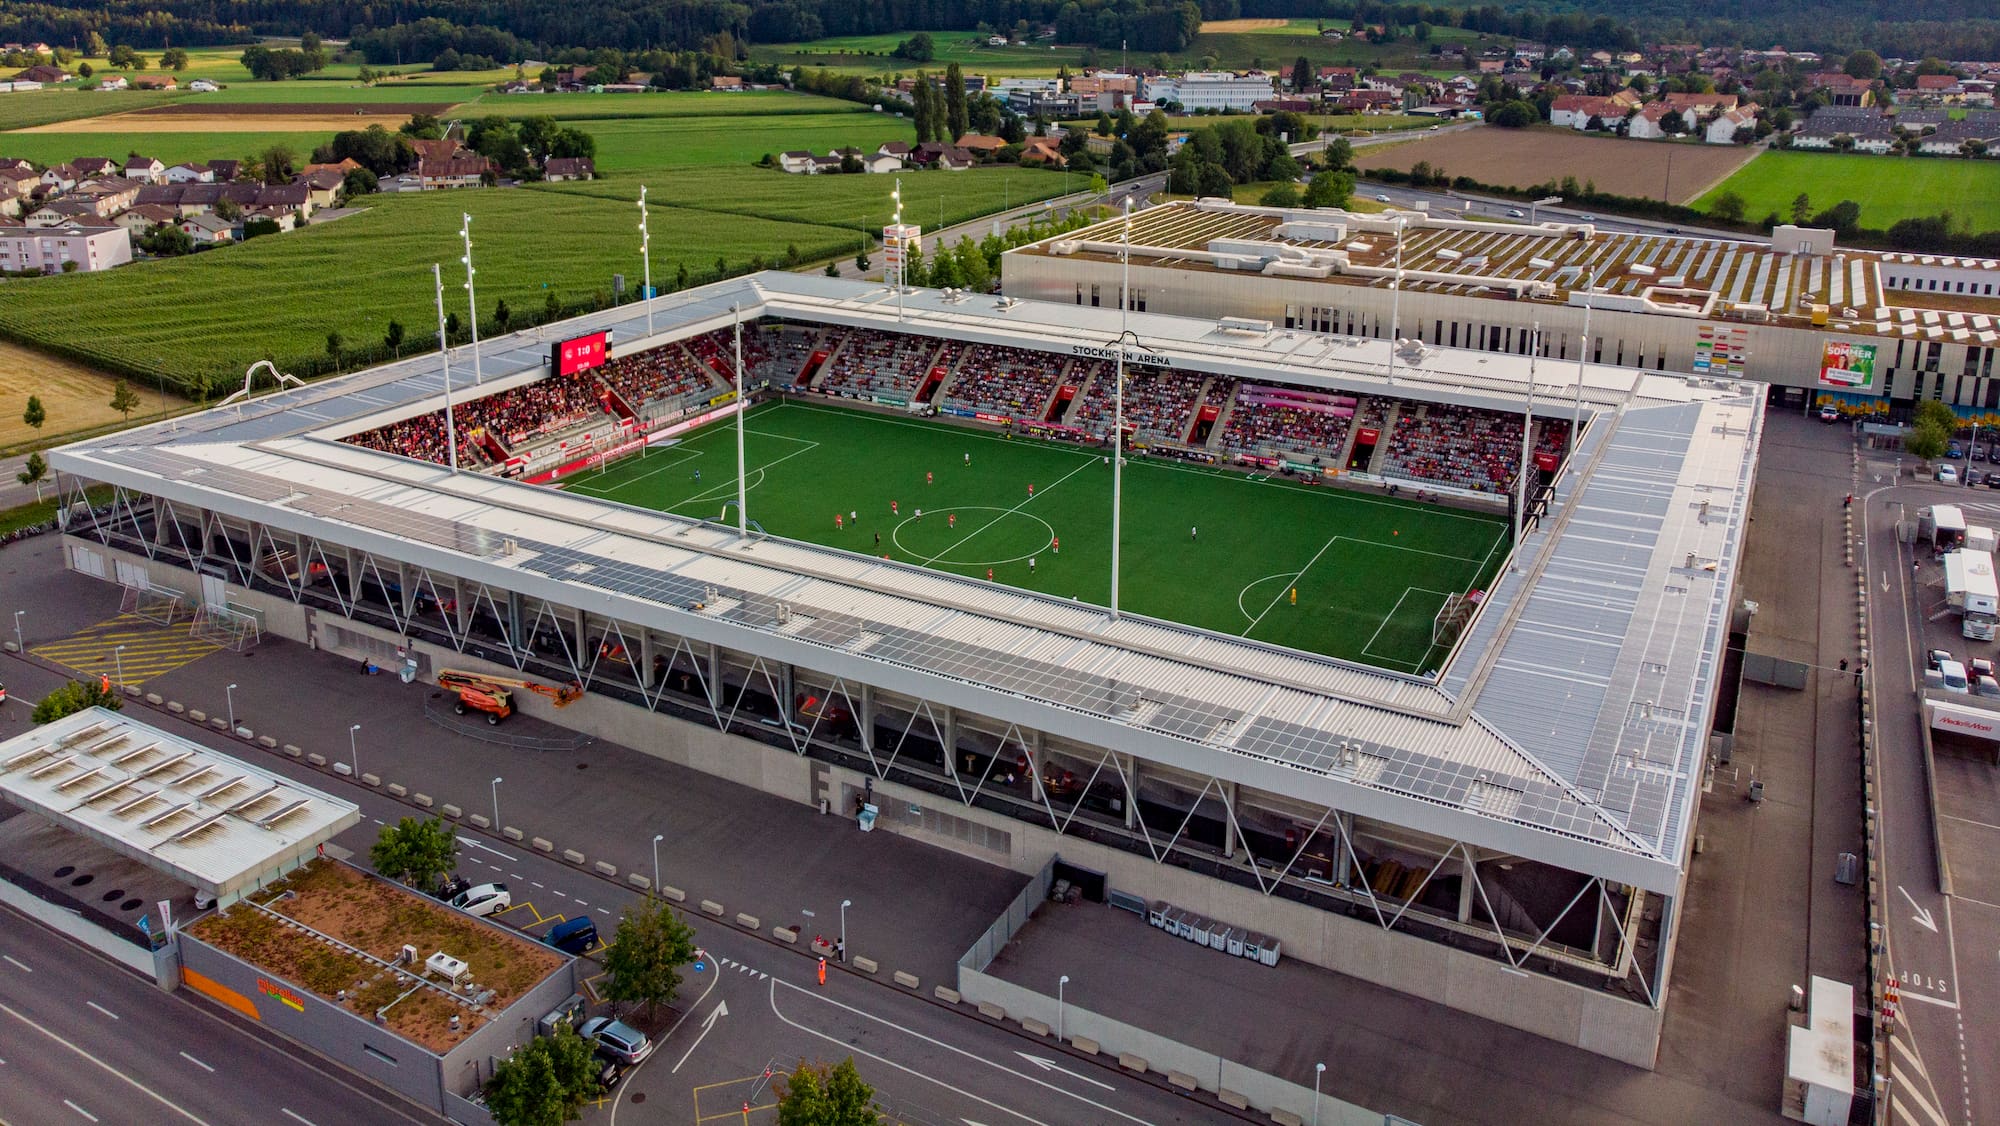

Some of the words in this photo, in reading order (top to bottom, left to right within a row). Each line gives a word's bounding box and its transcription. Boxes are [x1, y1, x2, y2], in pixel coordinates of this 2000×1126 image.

[577, 345, 590, 357] 1:0
[1827, 346, 1873, 359] SOMMER
[1137, 355, 1171, 366] ARENA
[1900, 970, 1947, 993] STOP
